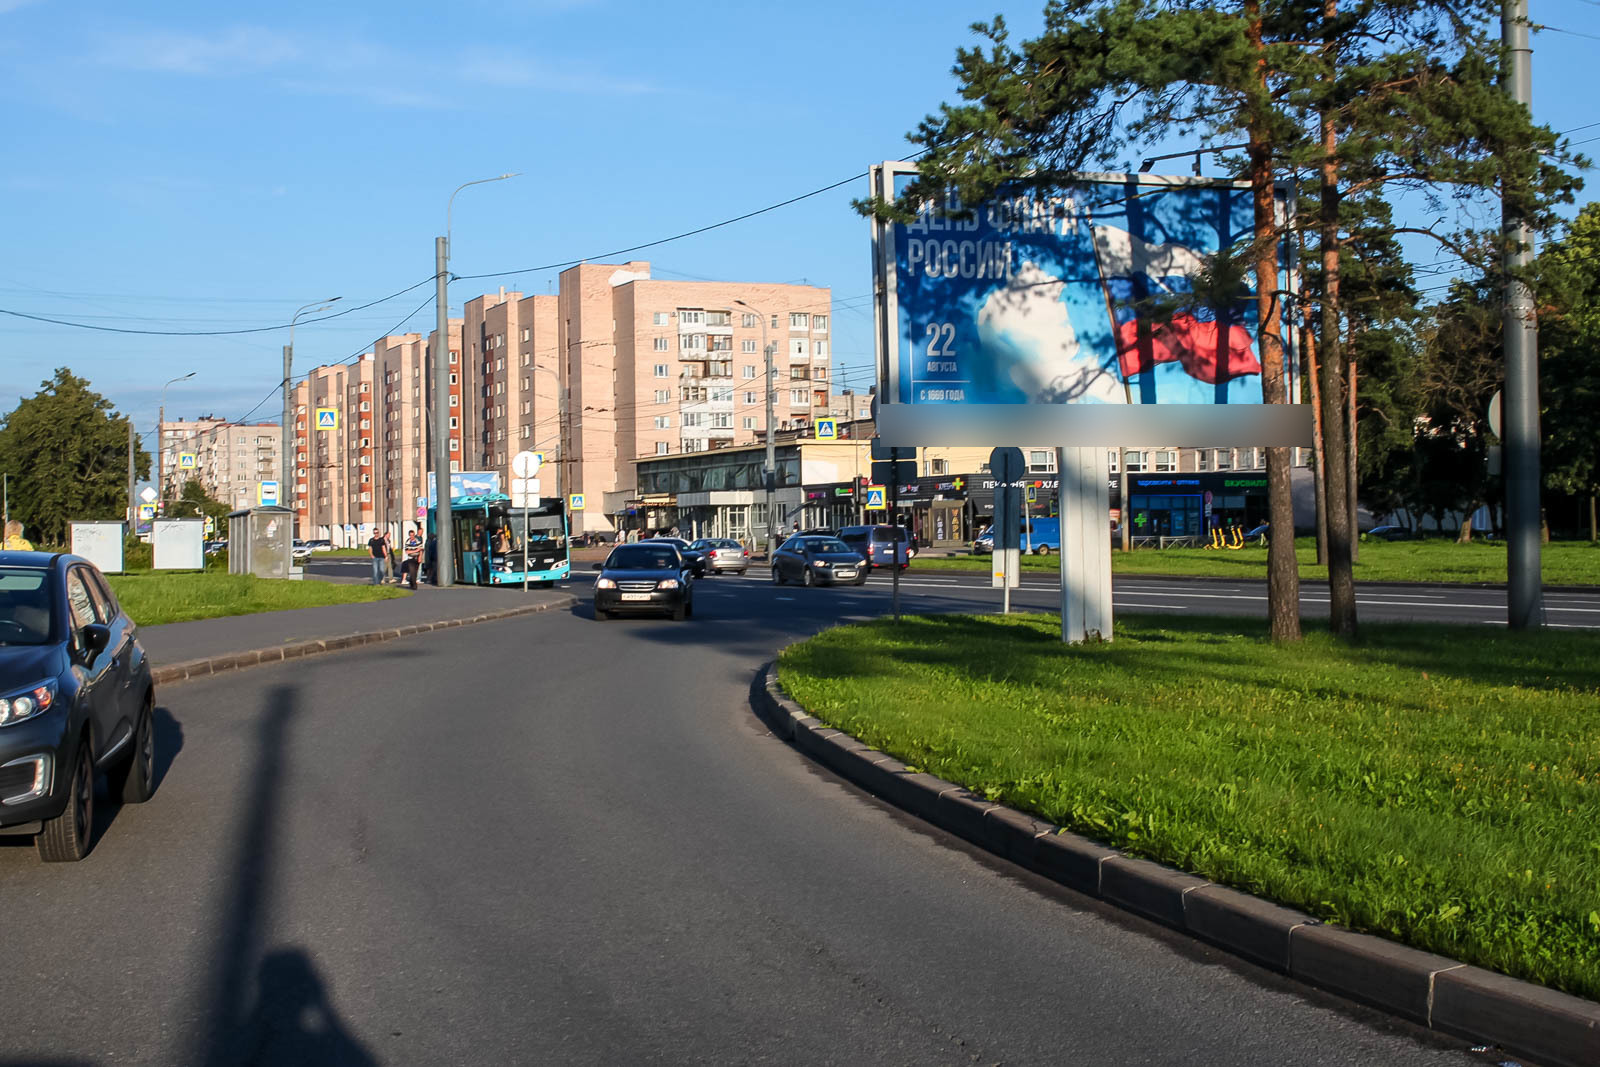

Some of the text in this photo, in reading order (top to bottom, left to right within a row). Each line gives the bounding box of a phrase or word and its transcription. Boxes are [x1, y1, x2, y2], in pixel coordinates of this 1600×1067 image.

[908, 238, 1013, 279] РОССИИ
[926, 322, 956, 357] 22
[927, 361, 957, 372] АВГУСТА
[920, 389, 927, 401] С
[946, 389, 965, 402] ГОДА
